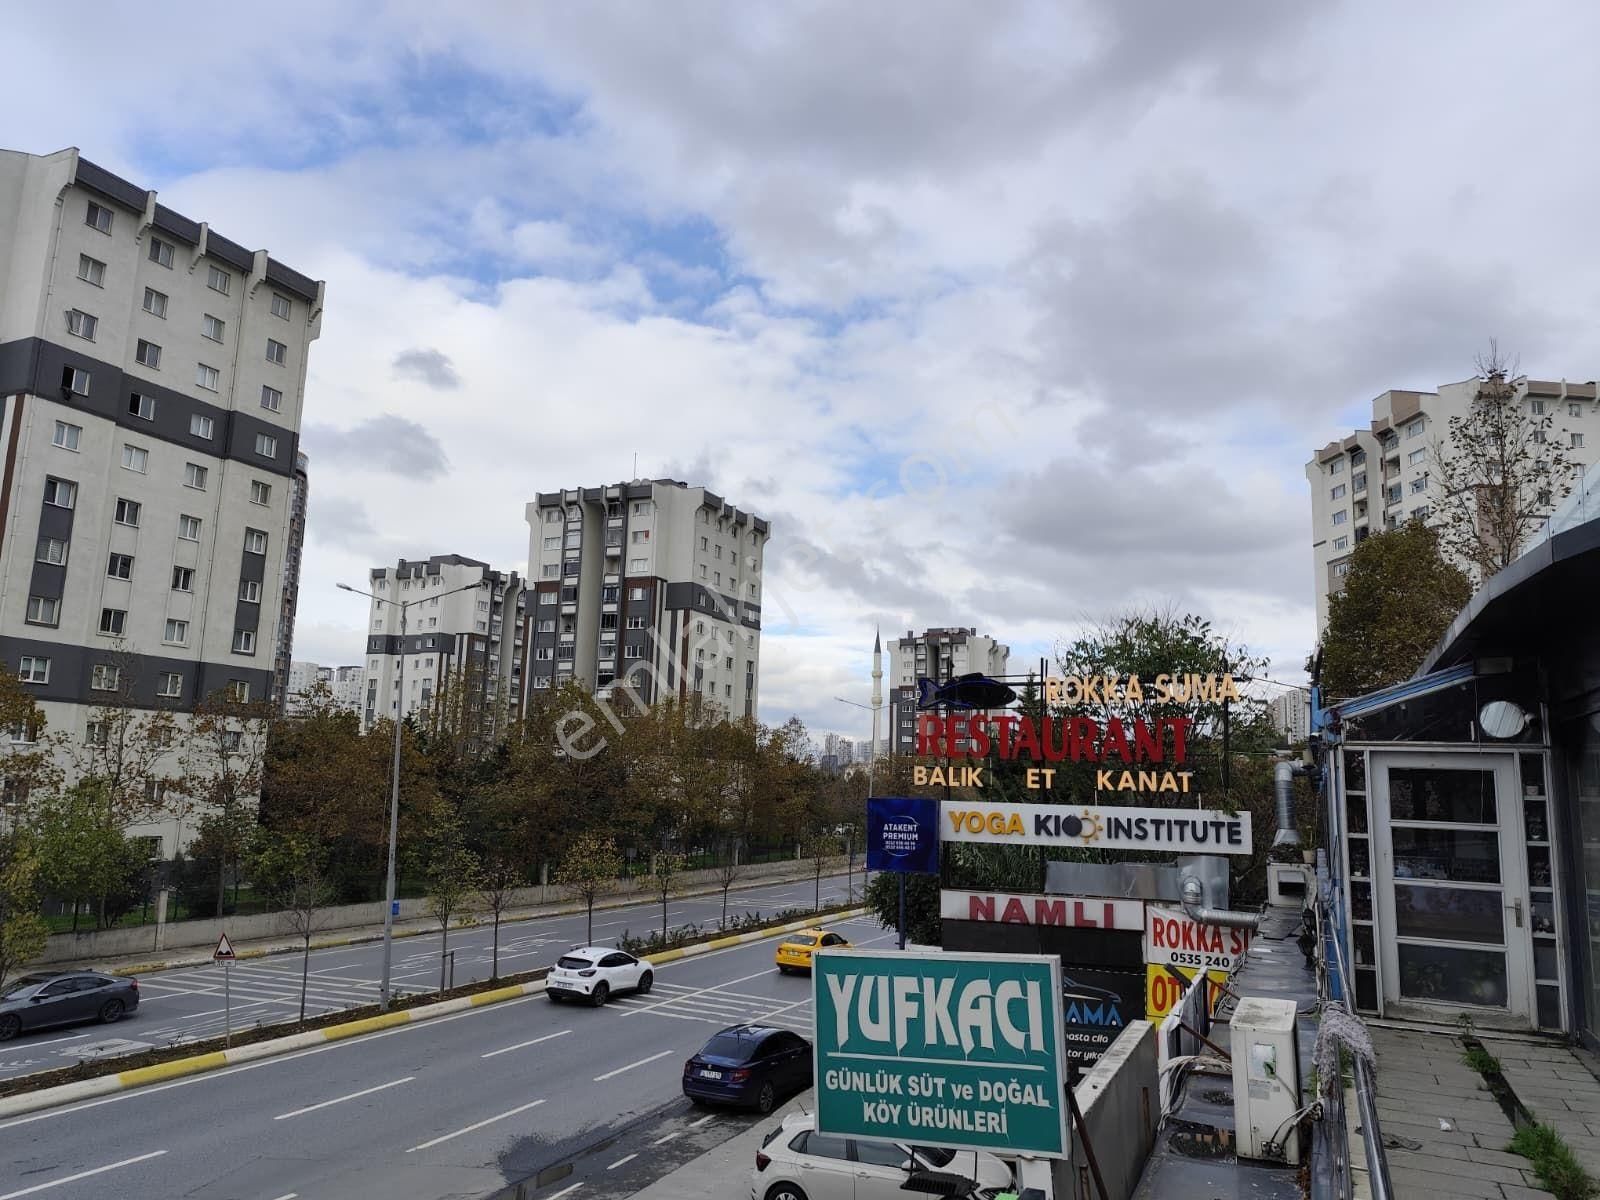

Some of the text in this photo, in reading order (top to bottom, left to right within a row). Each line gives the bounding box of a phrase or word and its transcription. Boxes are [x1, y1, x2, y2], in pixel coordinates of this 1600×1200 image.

[1045, 672, 1240, 705] ROKKA SUMA
[917, 714, 1193, 763] RESTAURANT
[913, 765, 1194, 793] BALIK ET KANAT
[882, 832, 919, 841] PREMIUM
[883, 823, 919, 832] ATAKENT
[949, 810, 1026, 836] YOGA
[1106, 816, 1243, 845] INSTITUTE
[968, 895, 1115, 929] NAMLI
[1152, 917, 1225, 954] ROKKA
[1170, 951, 1230, 968] 0535 240
[824, 968, 1051, 1062] YUFKACI
[825, 1068, 1052, 1108] GÜNLÜK SÜT ve DOĞAL
[863, 1099, 1008, 1134] KÖY ÜRÜNLERİ
